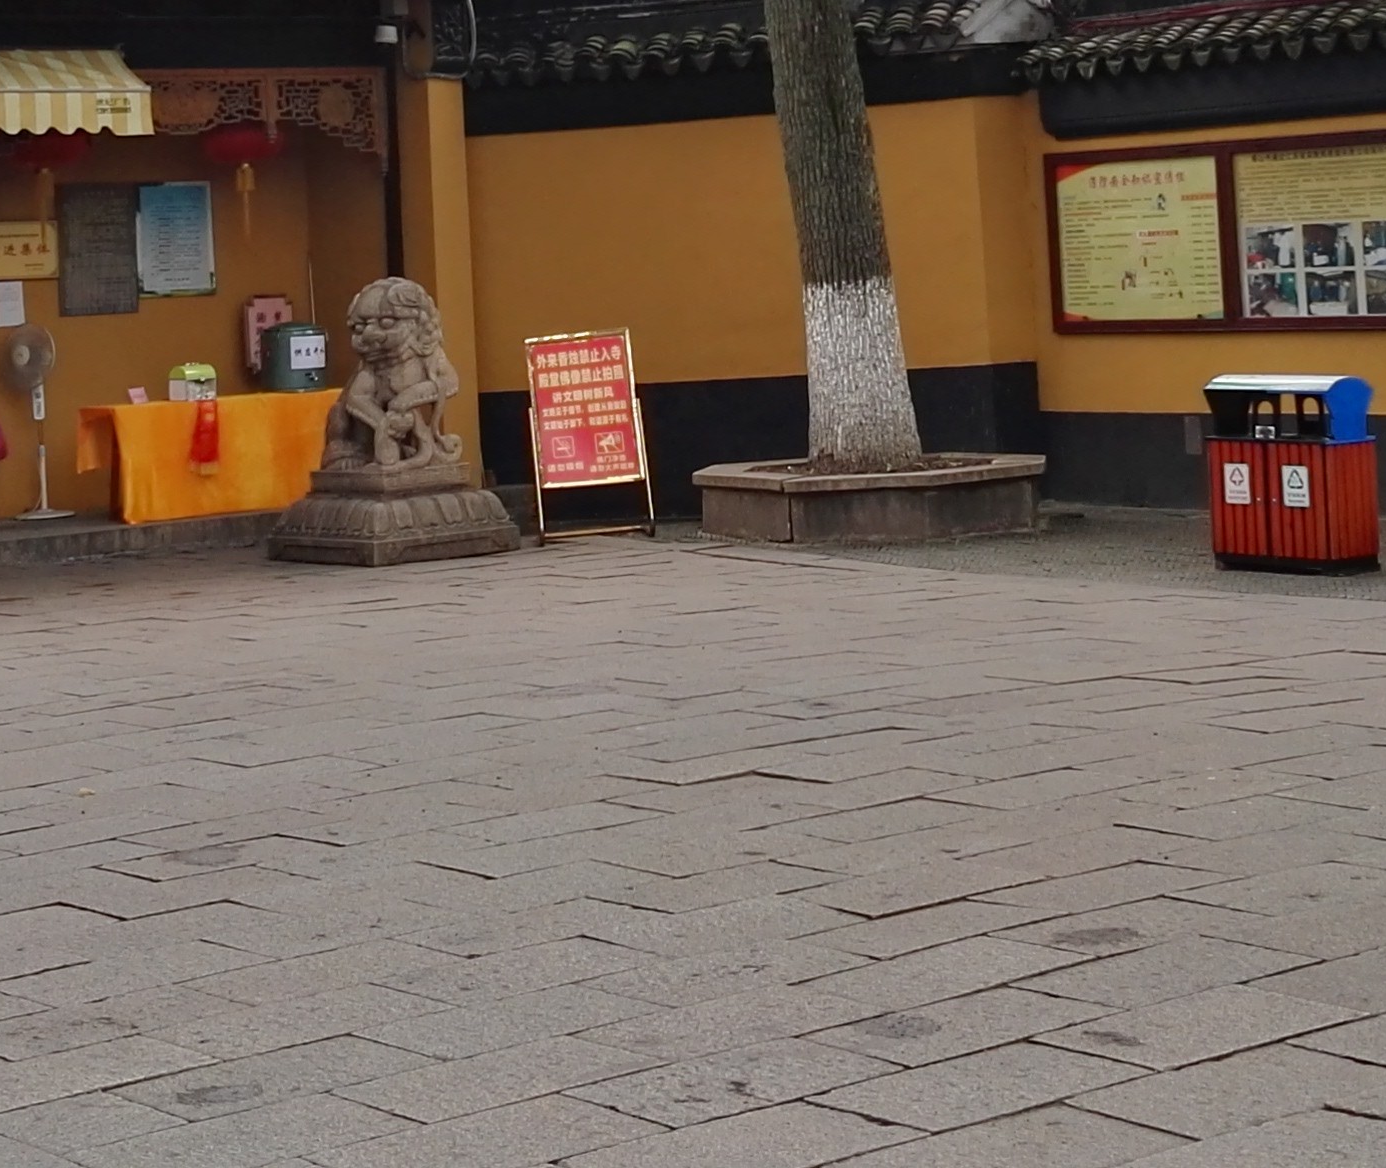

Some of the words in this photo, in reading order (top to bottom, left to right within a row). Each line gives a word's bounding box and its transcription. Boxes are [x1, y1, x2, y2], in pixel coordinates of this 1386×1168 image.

[536, 345, 621, 369] 外来香烛禁止入寺
[538, 364, 624, 388] 殿堂佛像禁止拍照
[552, 386, 614, 403] 讲文明树新风
